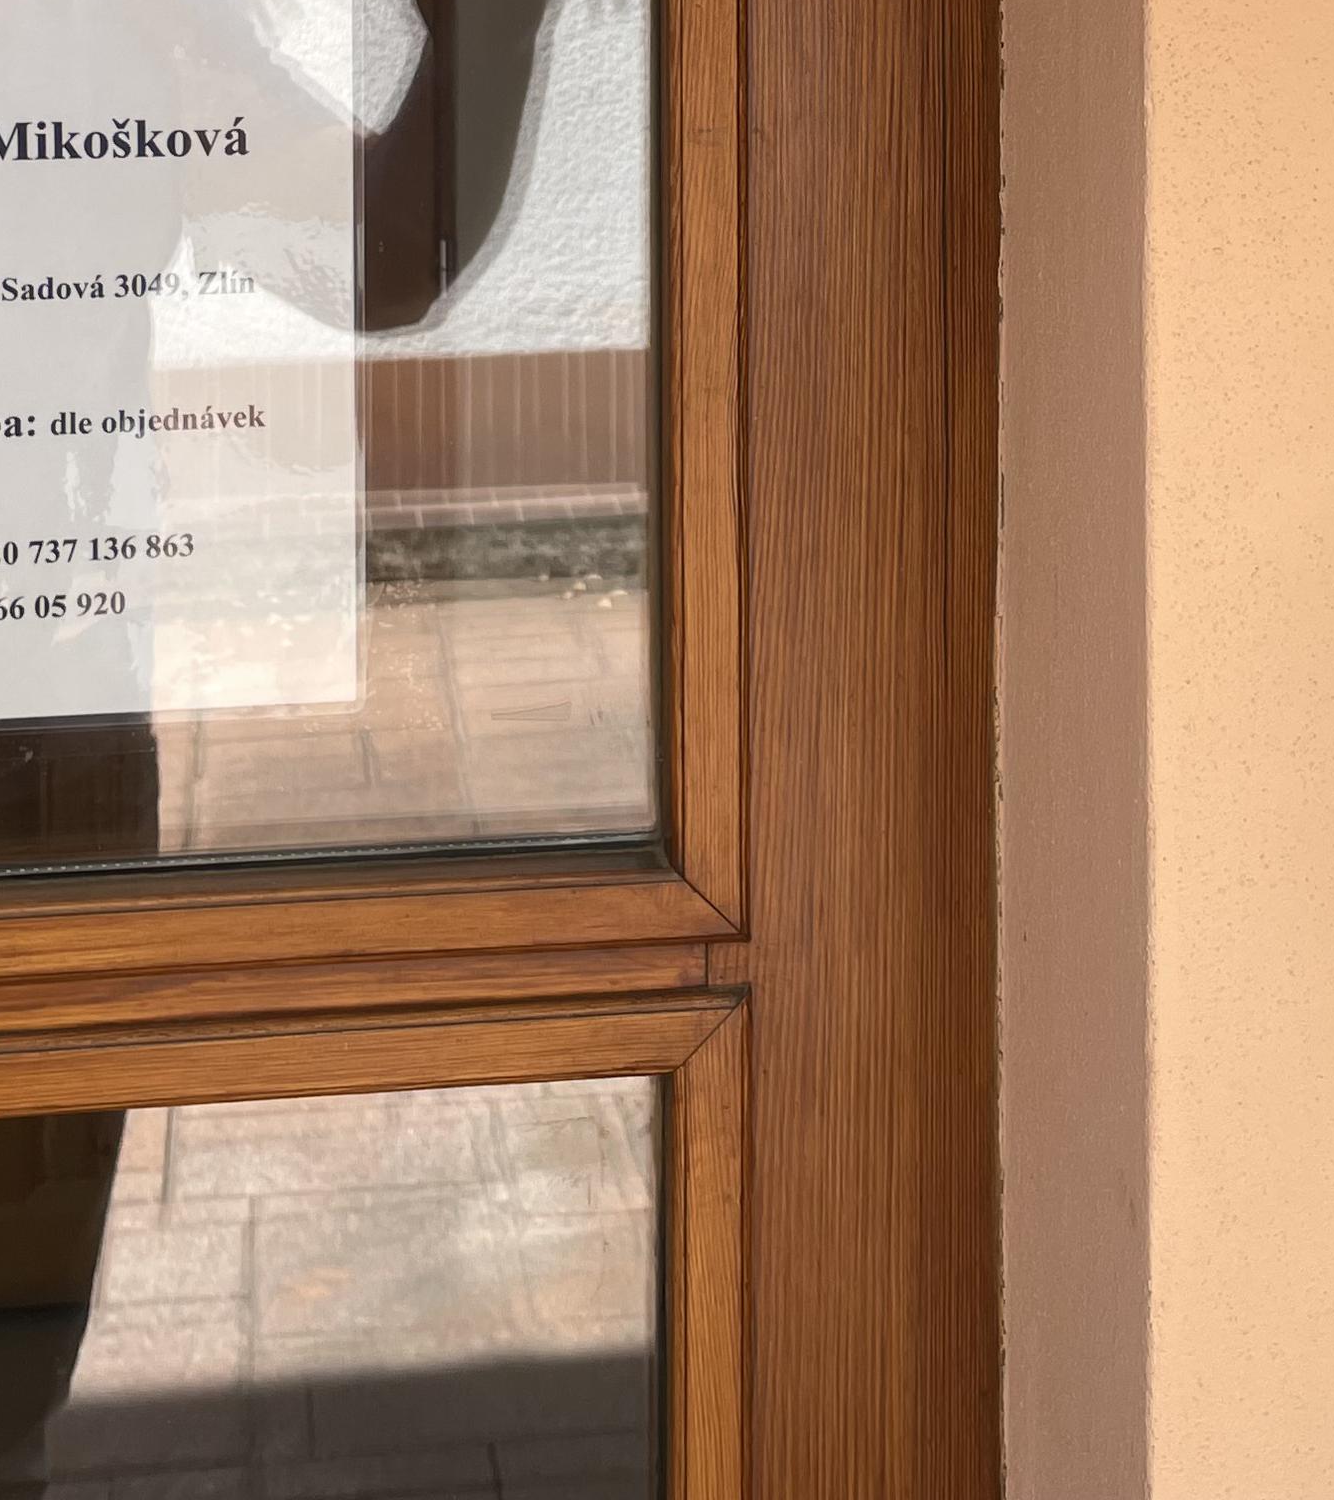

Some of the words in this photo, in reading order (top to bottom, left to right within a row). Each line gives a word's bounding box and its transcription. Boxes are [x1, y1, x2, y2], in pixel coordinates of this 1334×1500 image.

[1, 274, 105, 302] Sadová
[114, 272, 189, 301] 3049,
[197, 269, 255, 296] Zlín
[50, 411, 93, 436] dle
[101, 404, 266, 439] objednávek
[28, 538, 78, 565] 737
[89, 535, 137, 561] 136
[145, 532, 194, 559] 863
[34, 594, 67, 619] 05
[76, 590, 126, 617] 920
